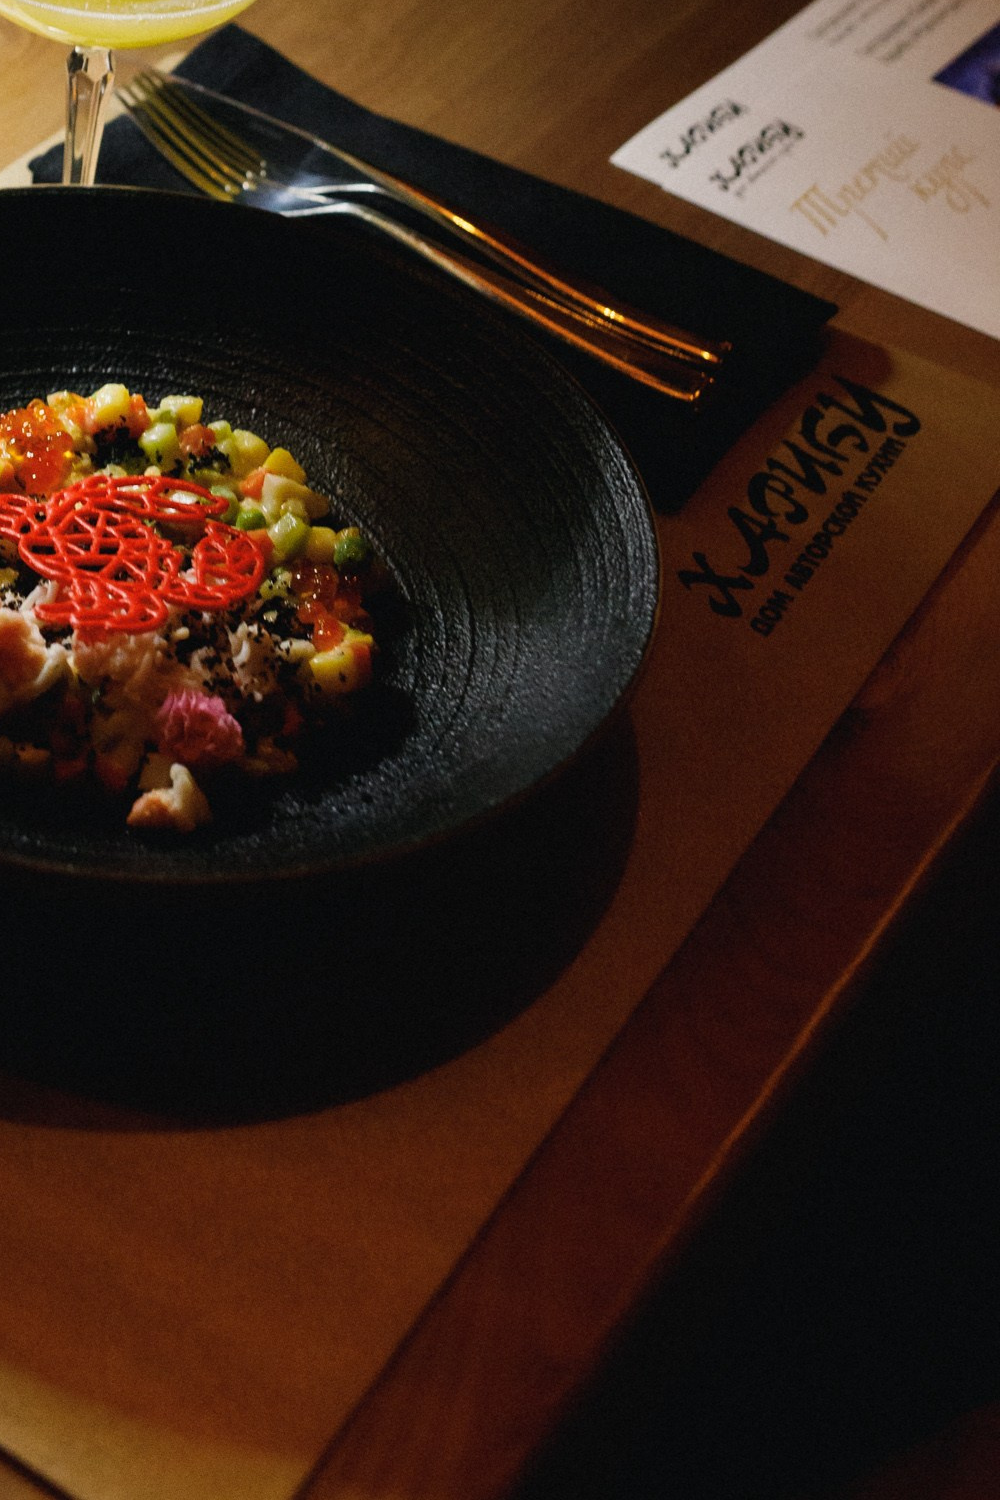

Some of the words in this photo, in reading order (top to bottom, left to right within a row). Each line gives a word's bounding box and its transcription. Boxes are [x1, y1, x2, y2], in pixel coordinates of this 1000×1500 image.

[678, 373, 921, 619] ХАРИБУ
[750, 590, 795, 638] ДОМ
[784, 489, 868, 591] АВТОРСКОЙ
[854, 436, 907, 493] КУХНИ
